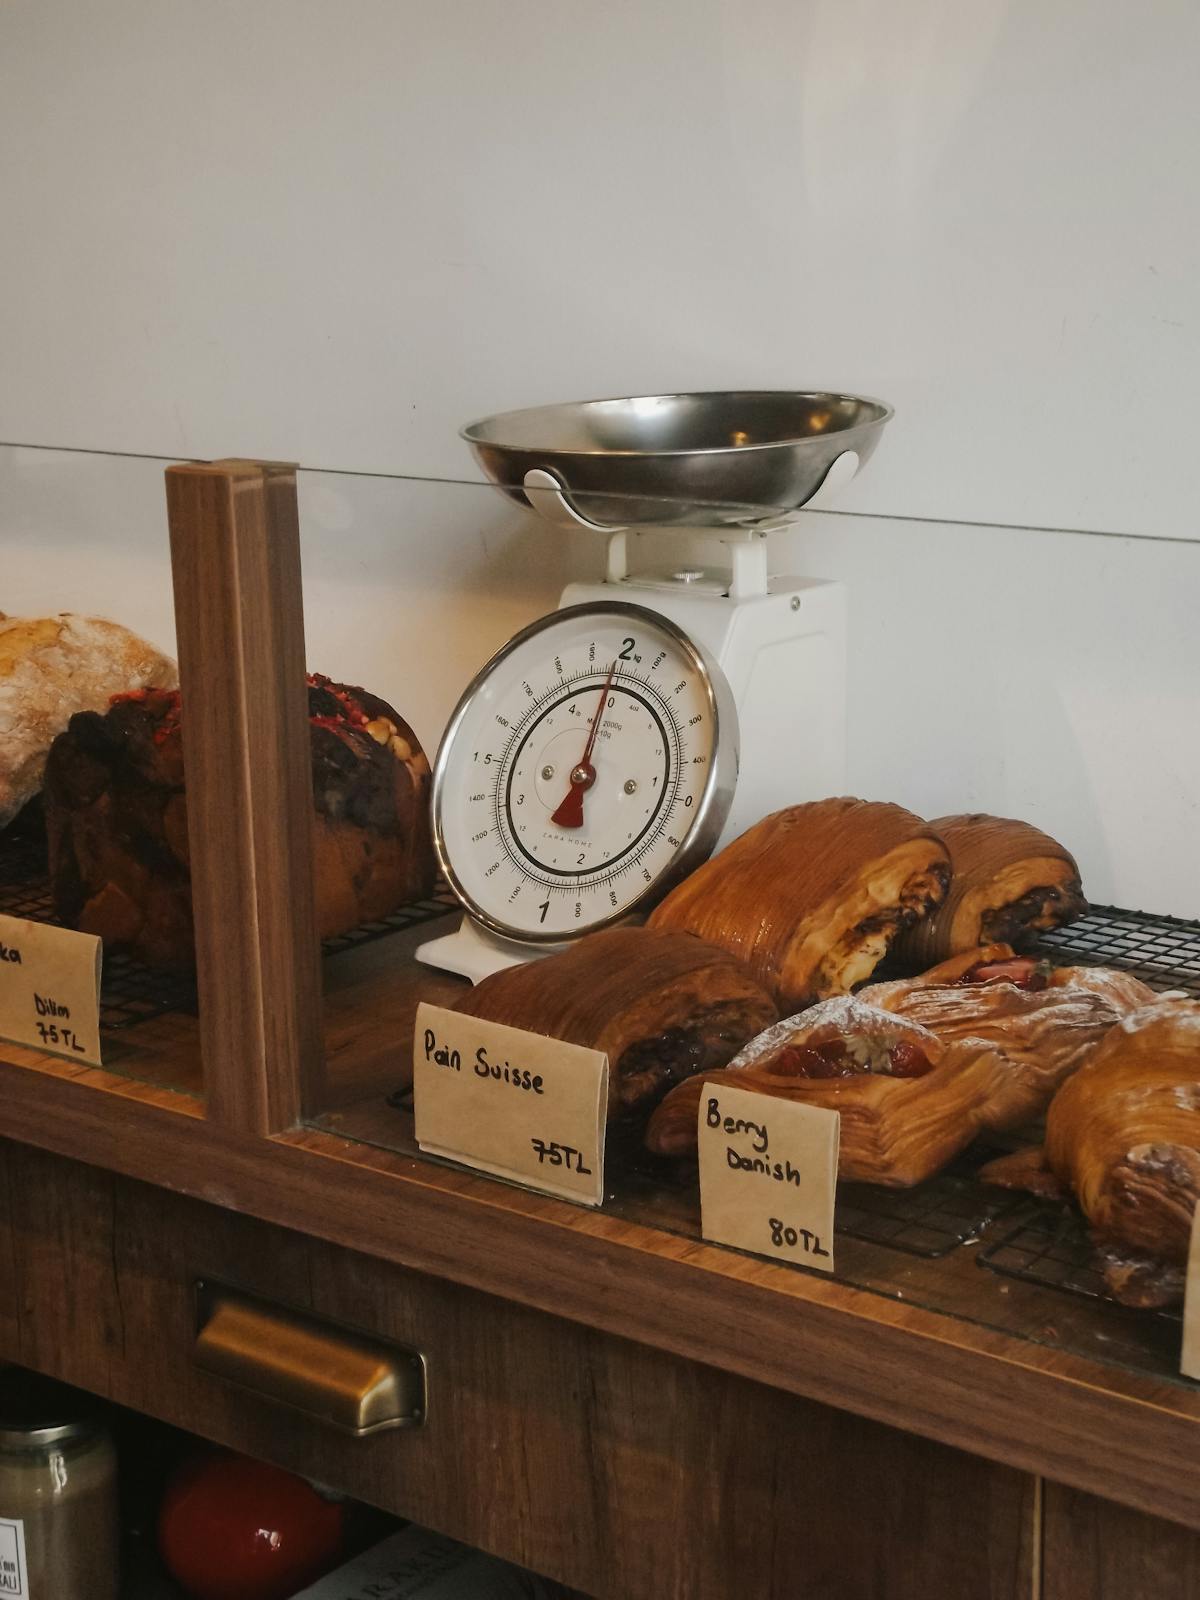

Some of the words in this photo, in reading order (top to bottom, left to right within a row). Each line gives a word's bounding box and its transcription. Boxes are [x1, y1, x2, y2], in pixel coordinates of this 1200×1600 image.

[618, 637, 636, 661] 2
[521, 681, 533, 697] 1700
[674, 680, 687, 694] 200
[568, 704, 576, 714] 4
[607, 697, 615, 708] 0
[688, 714, 702, 727] 300
[692, 756, 706, 764] 400
[652, 776, 658, 787] 1
[469, 793, 485, 802] 1400
[517, 794, 525, 805] 3
[471, 830, 488, 843] 1300
[576, 853, 586, 865] 2
[485, 862, 500, 878] 1200
[641, 868, 652, 882] 700
[508, 886, 521, 904] 1100
[539, 901, 550, 923] 1
[424, 1029, 461, 1071] Pain
[474, 1047, 545, 1095] Suisse
[707, 1098, 769, 1153] Berry
[531, 1138, 592, 1175] 75TL
[727, 1146, 801, 1187] Danish
[768, 1217, 830, 1257] 80TL
